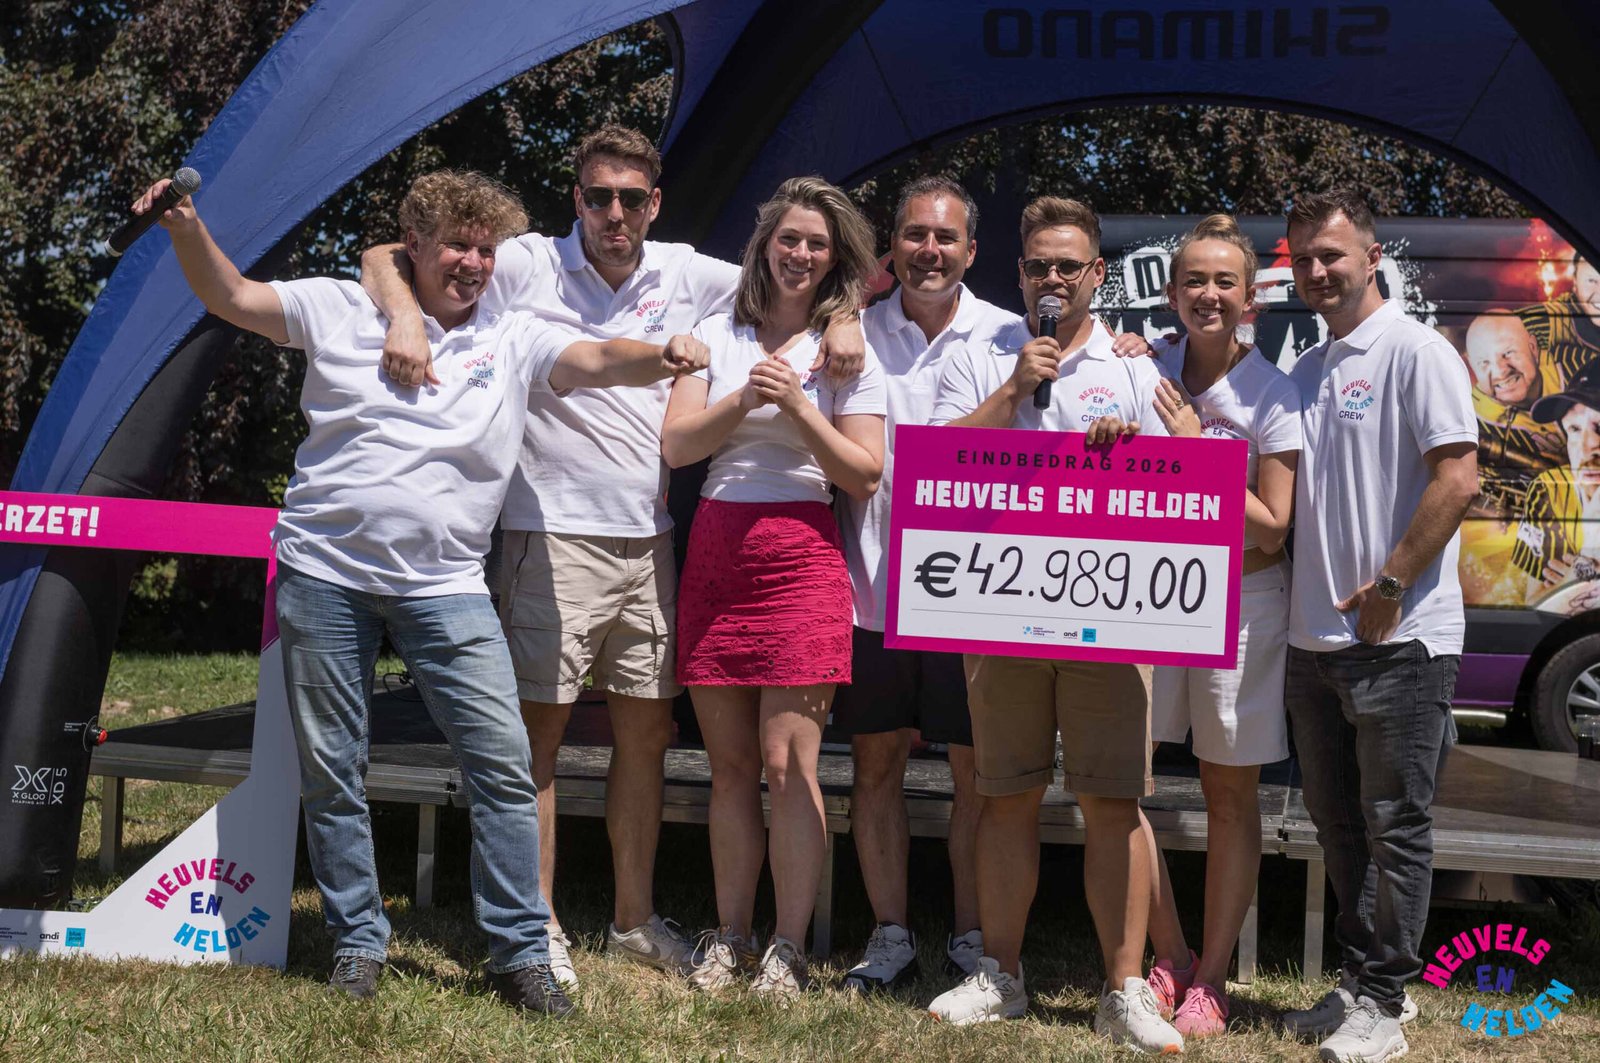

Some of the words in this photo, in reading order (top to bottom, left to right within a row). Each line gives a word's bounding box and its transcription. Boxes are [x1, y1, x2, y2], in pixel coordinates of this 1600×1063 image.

[644, 325, 664, 333] CREW
[467, 377, 489, 389] CREW
[1341, 379, 1372, 396] HEUVELS
[1078, 386, 1116, 401] HEUVELS
[1092, 395, 1105, 405] EN
[1351, 389, 1362, 399] EN
[1087, 402, 1120, 416] HELDEN
[1344, 396, 1375, 411] HELDEN
[1338, 410, 1365, 421] CREW
[1200, 417, 1236, 432] HEUVELS
[1212, 427, 1225, 438] EN
[957, 450, 1113, 471] EINDBEDRAG
[1125, 458, 1182, 475] 2026
[915, 479, 1045, 513] HEUVELS
[1057, 486, 1094, 515] EN
[1107, 489, 1221, 521] HELDEN
[0, 502, 100, 538] RZET!
[913, 542, 1208, 615] €42.989,00
[21, 792, 46, 800] GLOO
[145, 858, 256, 910] HEUVELS
[190, 891, 223, 917] EN
[39, 931, 60, 940] andi
[173, 906, 272, 953] HELDEN
